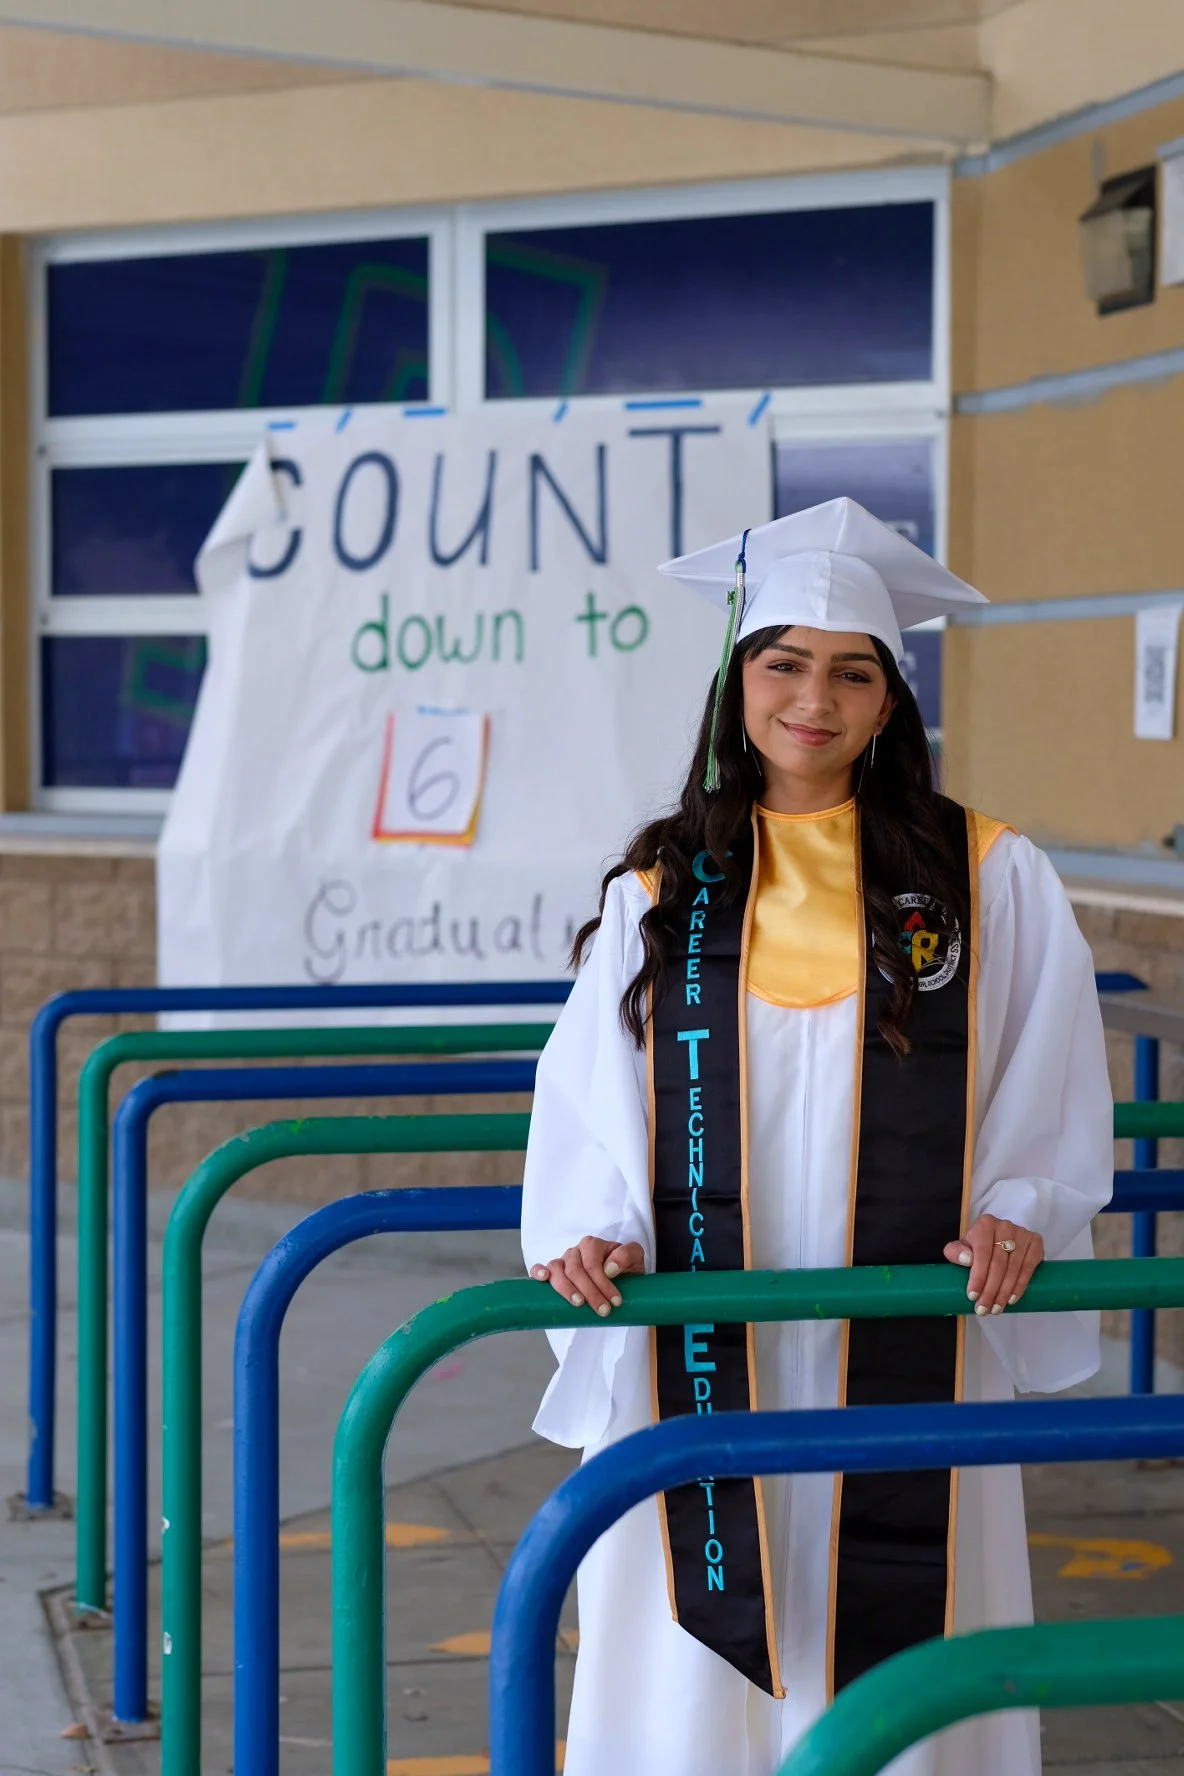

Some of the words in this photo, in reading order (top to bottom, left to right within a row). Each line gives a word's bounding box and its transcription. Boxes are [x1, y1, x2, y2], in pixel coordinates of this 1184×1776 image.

[248, 425, 721, 577] COUNT
[350, 592, 525, 673] down
[575, 591, 650, 660] to
[406, 735, 461, 822] 6
[685, 849, 733, 1005] CAREER
[677, 1028, 710, 1272] TECHNICA
